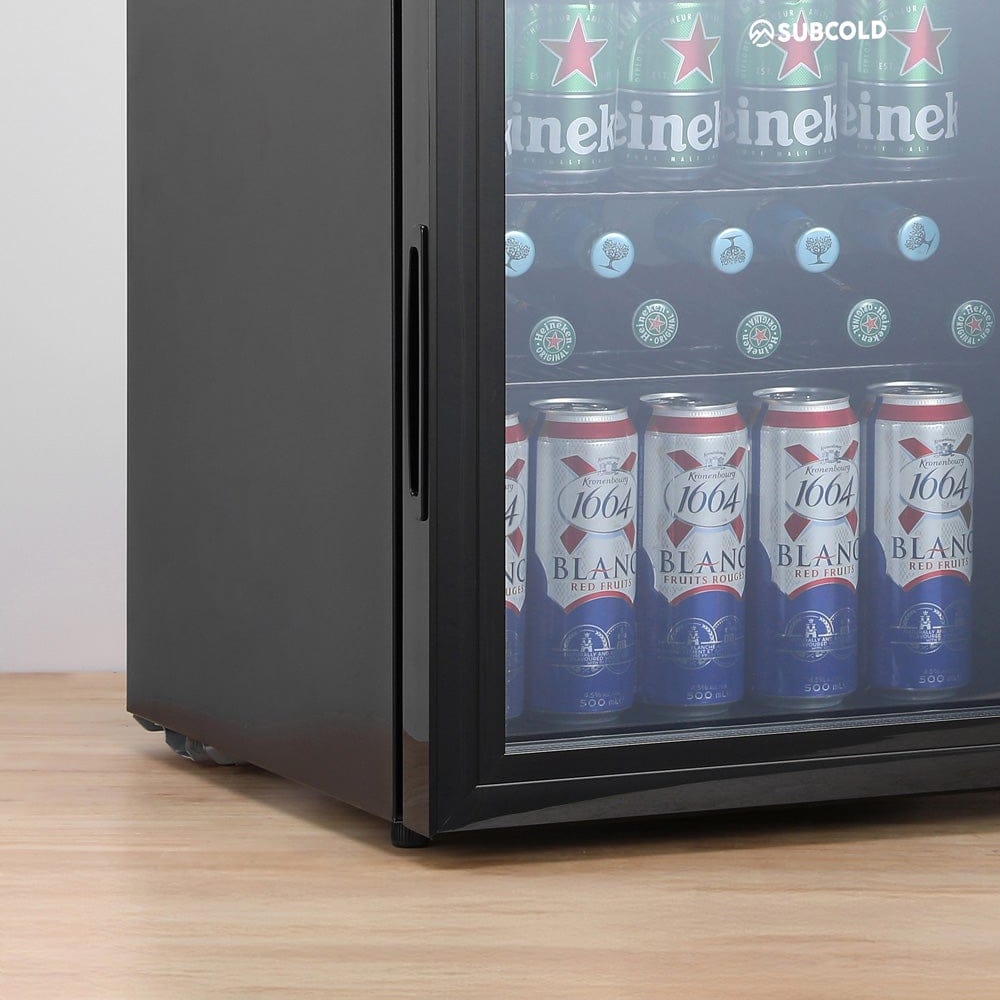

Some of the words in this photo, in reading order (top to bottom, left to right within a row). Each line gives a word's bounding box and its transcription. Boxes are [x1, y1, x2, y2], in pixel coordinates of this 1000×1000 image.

[778, 20, 887, 42] SUBCOLD
[636, 303, 667, 342] Heineken
[746, 315, 777, 331] ORIGINAL
[851, 304, 875, 330] ORIGINAL
[860, 304, 890, 343] Heineken
[964, 303, 994, 340] Heineken
[534, 321, 573, 344] Heineken
[653, 311, 676, 345] ORIGINAL
[956, 315, 976, 345] ORIGINAL
[742, 334, 779, 356] Heineken
[535, 346, 570, 362] ORIGINAL
[805, 464, 850, 477] Kronenbourg
[919, 457, 965, 469] Kronenbourg
[582, 476, 629, 488] Kronenbourg
[688, 471, 736, 483] Kronenbourg
[909, 467, 969, 500] 1664
[677, 479, 741, 514] 1664
[795, 473, 855, 507] 1664
[572, 485, 633, 520] 1664
[795, 569, 819, 578] RED
[824, 565, 855, 577] FRUITS
[909, 561, 933, 571] RED
[938, 559, 969, 570] FRUITS
[571, 582, 596, 592] RED
[600, 579, 632, 590] FRUITS
[664, 574, 708, 585] FRUITS
[712, 571, 745, 583] ROUGES
[919, 674, 945, 684] 500
[687, 691, 712, 700] 500
[805, 683, 830, 692] 500
[580, 698, 606, 708] 500
